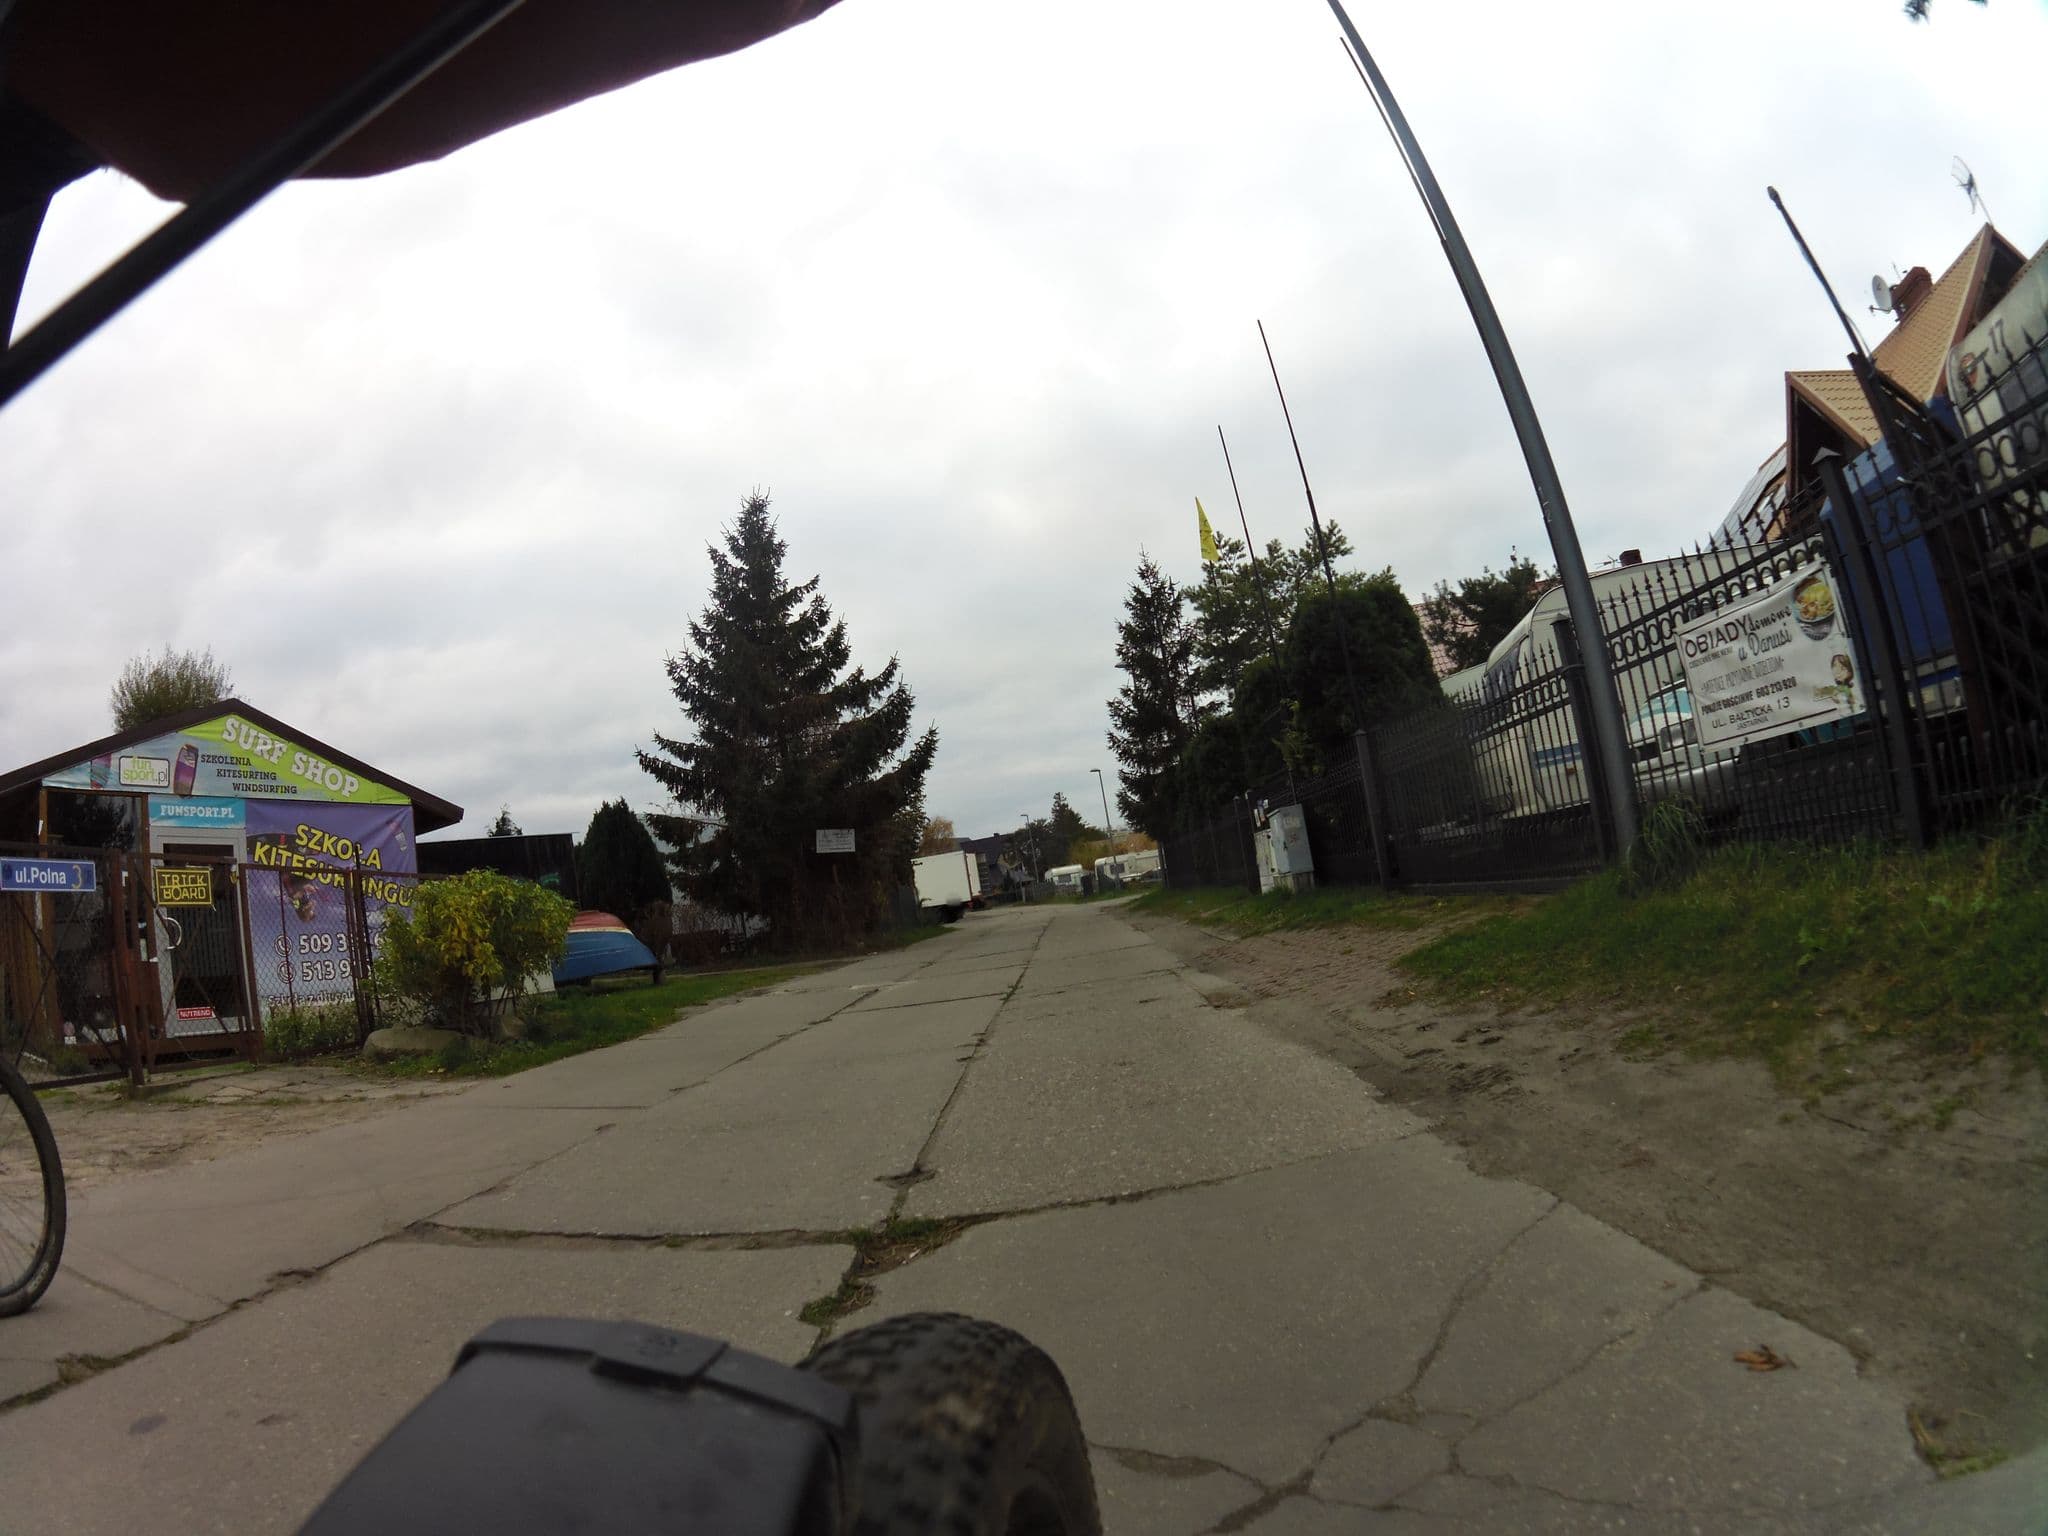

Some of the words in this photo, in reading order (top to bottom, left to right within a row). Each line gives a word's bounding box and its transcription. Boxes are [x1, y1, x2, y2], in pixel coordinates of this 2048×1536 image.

[1685, 615, 1748, 657] OBIADY
[1729, 704, 1773, 723] BAŁTYCKA
[1777, 696, 1790, 710] 13
[200, 754, 252, 767] SZKOLENIA
[222, 717, 288, 765] SURF
[291, 751, 360, 797] SHOP
[123, 768, 168, 785] sport.pl
[216, 768, 277, 781] KITESURFING
[232, 782, 298, 795] WINDSURFING
[160, 805, 235, 818] FUNSPORT.PL
[15, 866, 67, 885] ul.Polna
[160, 873, 207, 887] TRICK
[163, 887, 207, 901] BOARD
[299, 933, 333, 954] 509
[302, 960, 335, 981] 513
